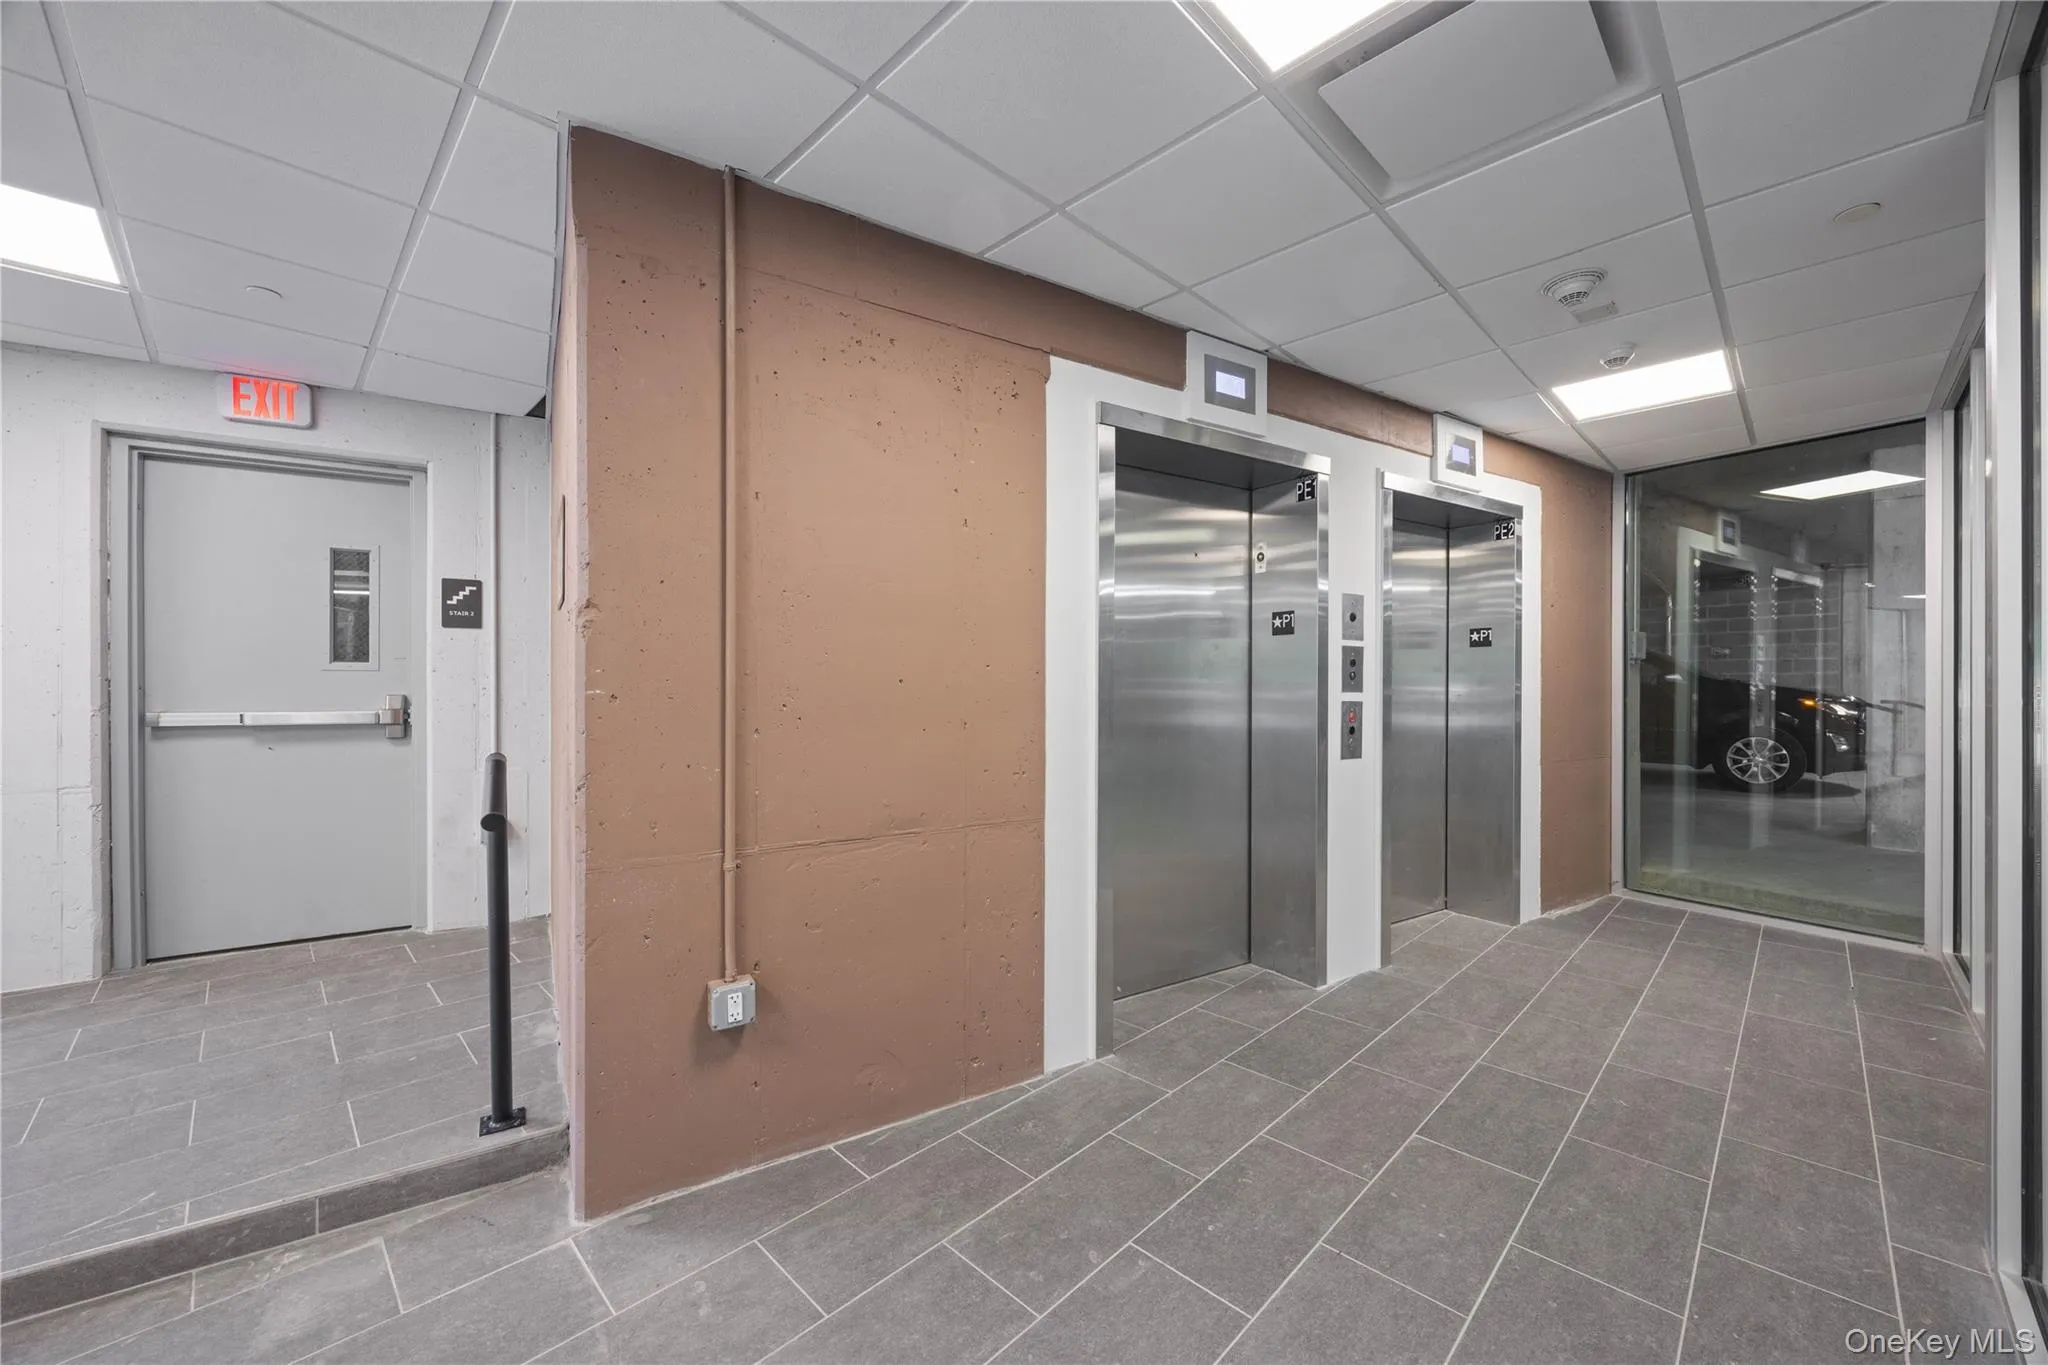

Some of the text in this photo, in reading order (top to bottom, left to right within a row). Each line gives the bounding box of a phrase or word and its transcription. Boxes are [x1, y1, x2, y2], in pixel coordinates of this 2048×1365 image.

[231, 376, 299, 421] EXIT
[1296, 479, 1317, 502] PE1
[1493, 522, 1515, 540] PE2
